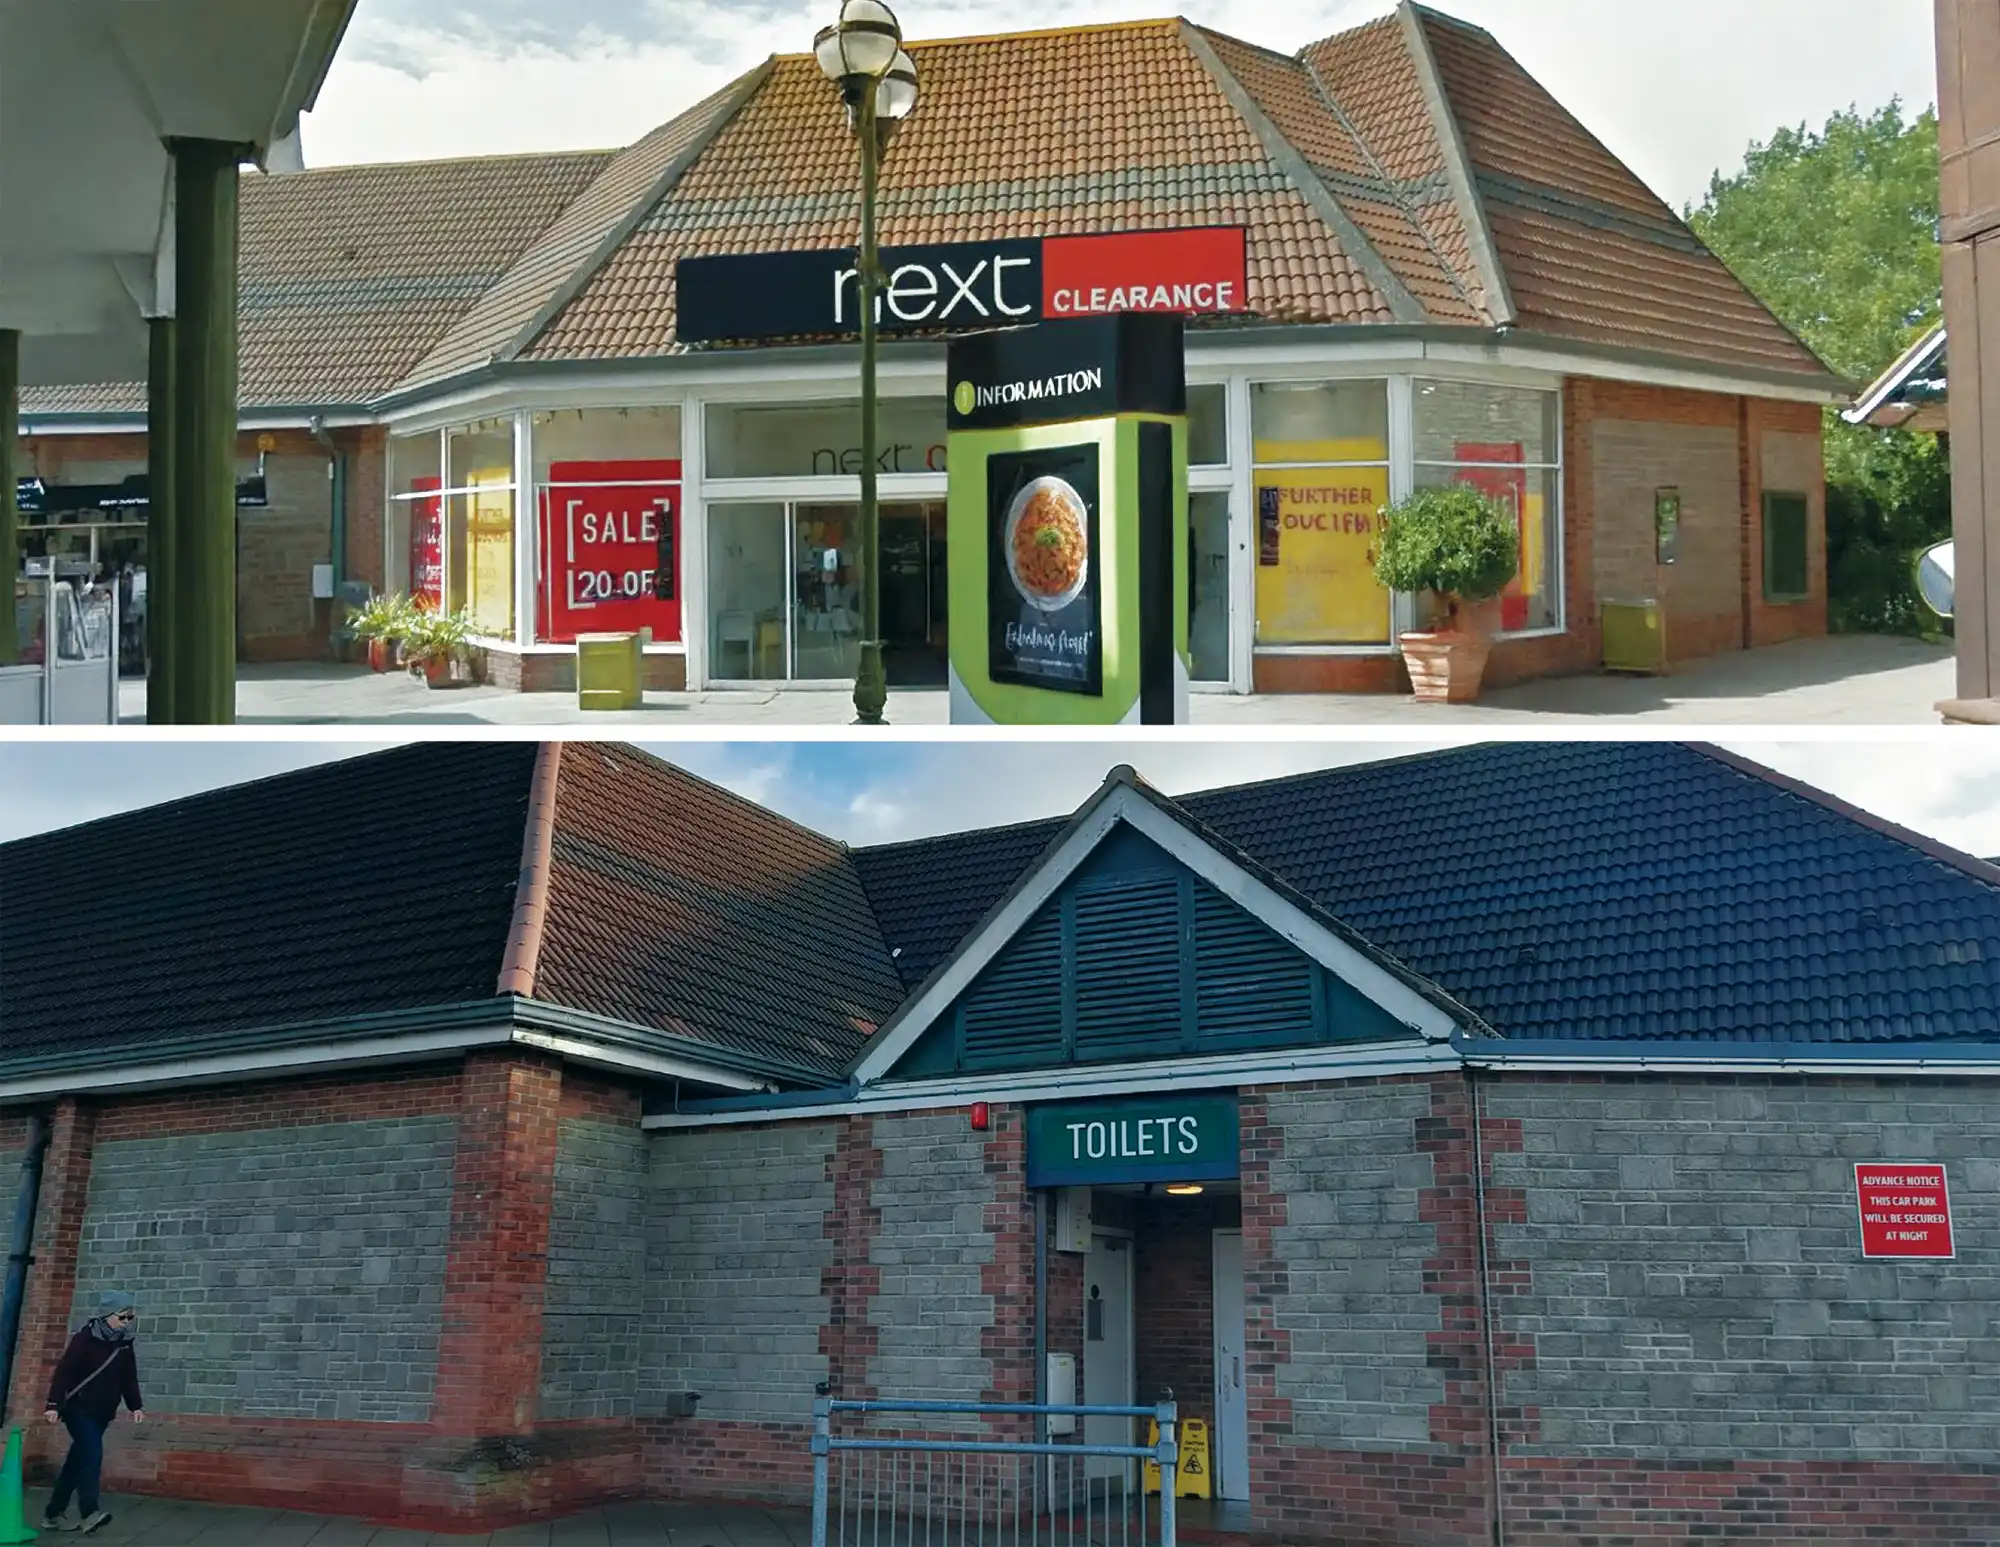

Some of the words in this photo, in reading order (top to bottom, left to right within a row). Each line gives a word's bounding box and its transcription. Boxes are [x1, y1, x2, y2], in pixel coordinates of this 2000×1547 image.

[834, 254, 1032, 324] next
[1053, 281, 1233, 312] CLEARANCE
[977, 367, 1102, 407] INFORMATION
[582, 510, 660, 544] SALE
[1066, 1115, 1198, 1159] TOILETS
[1906, 1176, 1941, 1187] NOTICE
[1869, 1196, 1891, 1206] THIS
[1892, 1196, 1911, 1206] CAR
[1912, 1196, 1937, 1206] PARK
[1864, 1213, 1889, 1223] WILL
[1890, 1214, 1903, 1223] BE
[1904, 1214, 1946, 1224] SECURED
[1885, 1231, 1897, 1241] AT
[1899, 1231, 1928, 1241] NIGHT
